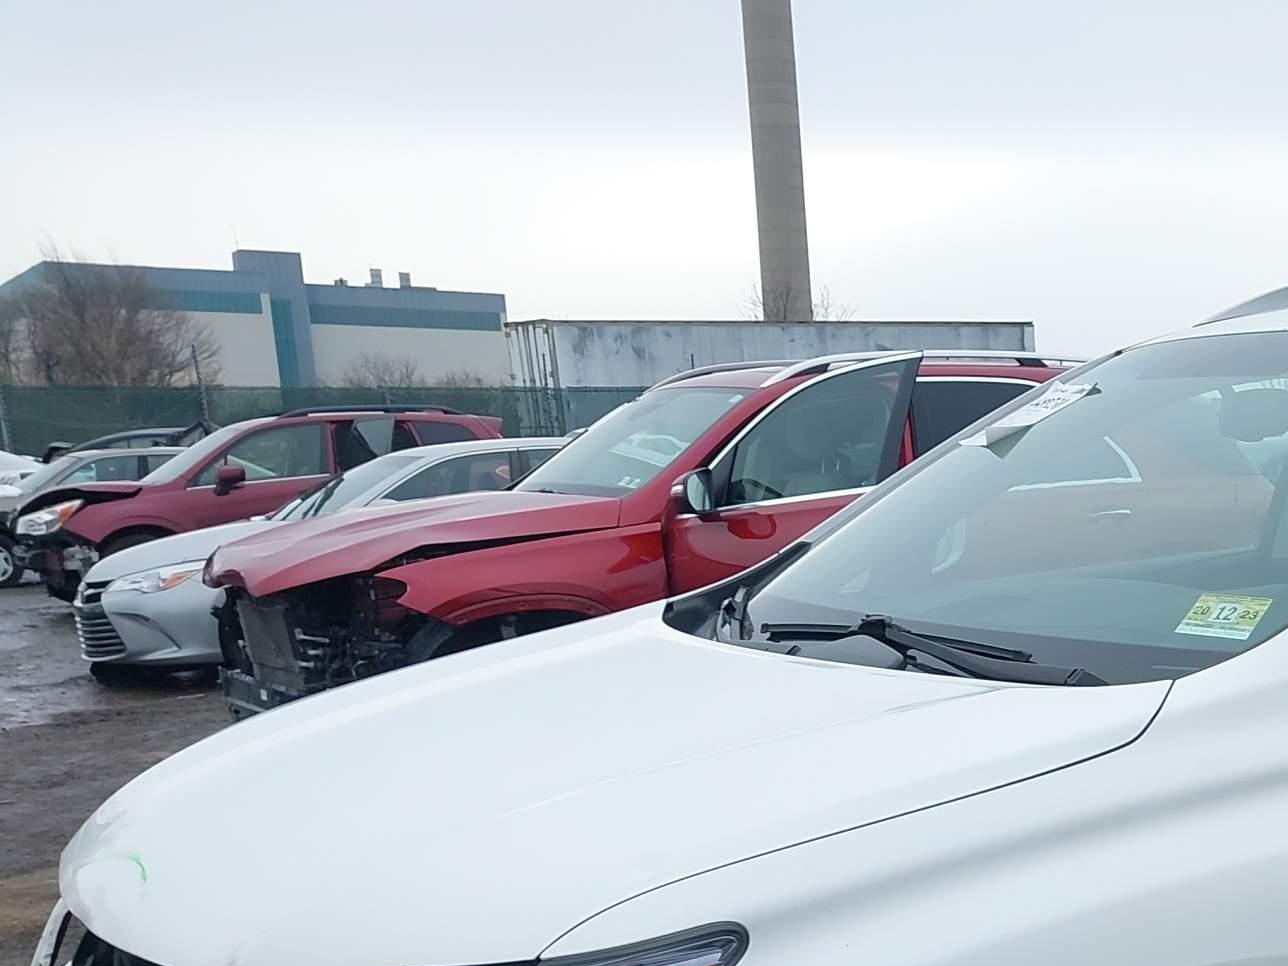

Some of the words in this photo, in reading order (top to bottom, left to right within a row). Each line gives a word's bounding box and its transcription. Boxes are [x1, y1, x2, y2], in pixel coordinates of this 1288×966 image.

[1192, 605, 1211, 616] 20
[1213, 605, 1238, 621] 12
[1239, 610, 1260, 620] 23
